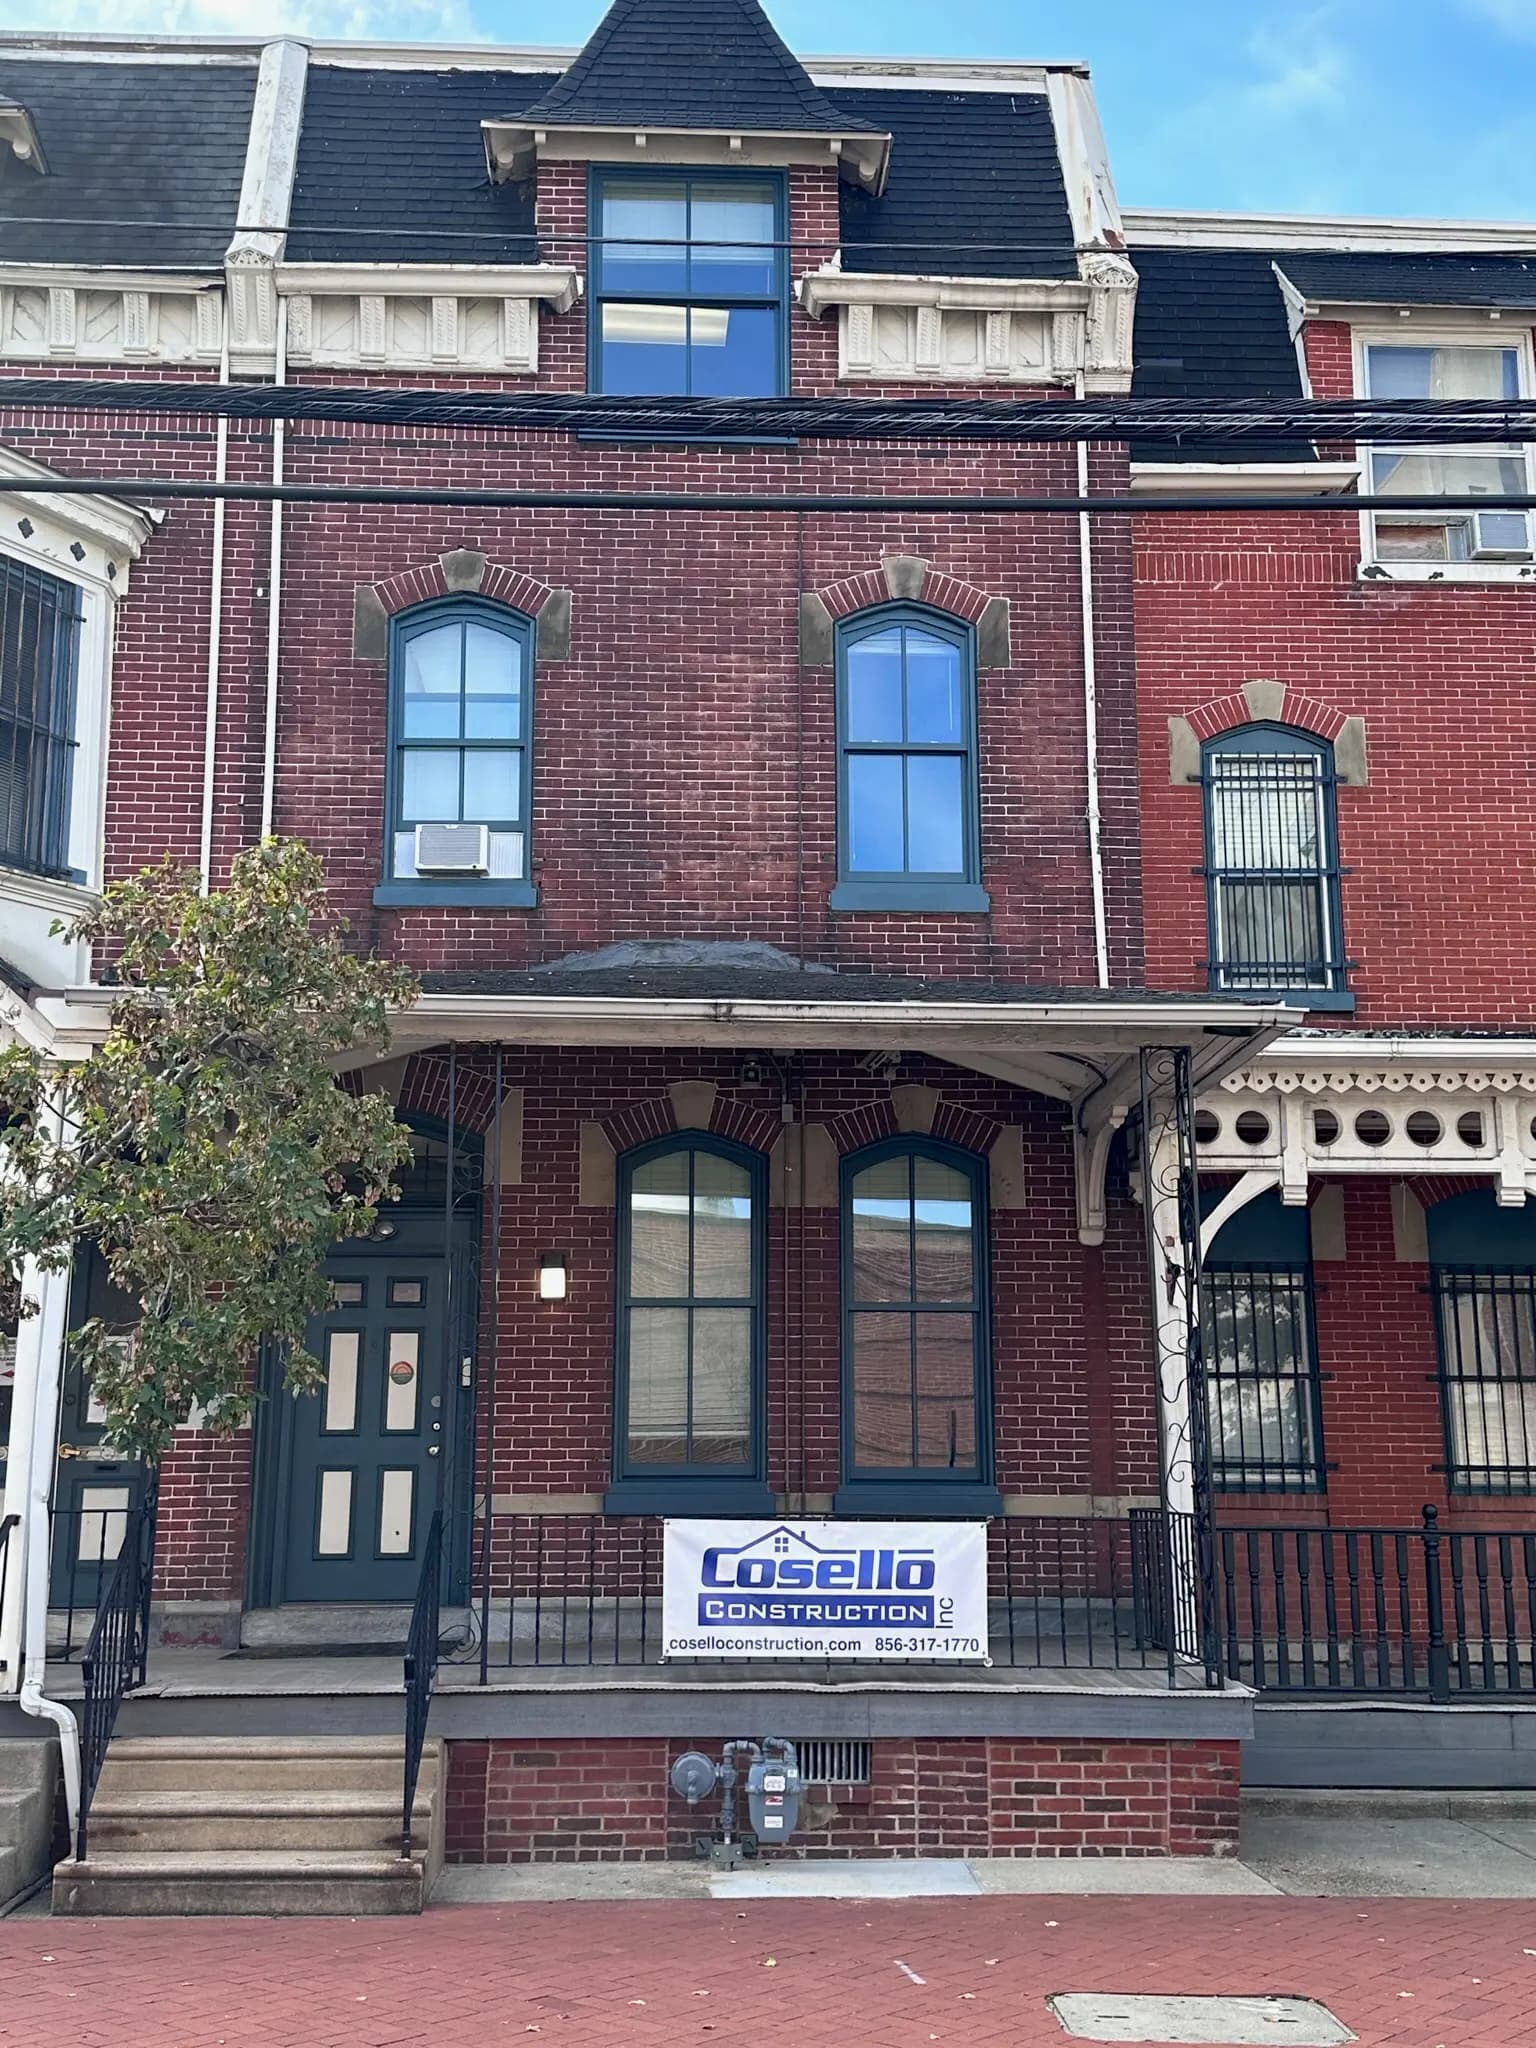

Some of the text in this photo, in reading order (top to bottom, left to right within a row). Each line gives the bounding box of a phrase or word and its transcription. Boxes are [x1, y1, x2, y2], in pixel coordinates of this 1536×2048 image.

[701, 1547, 936, 1590] Cosello
[705, 1600, 928, 1622] CONSTRUCTION
[935, 1597, 954, 1629] Inc
[669, 1636, 979, 1653] coselloconstruction.com 856-317-1770
